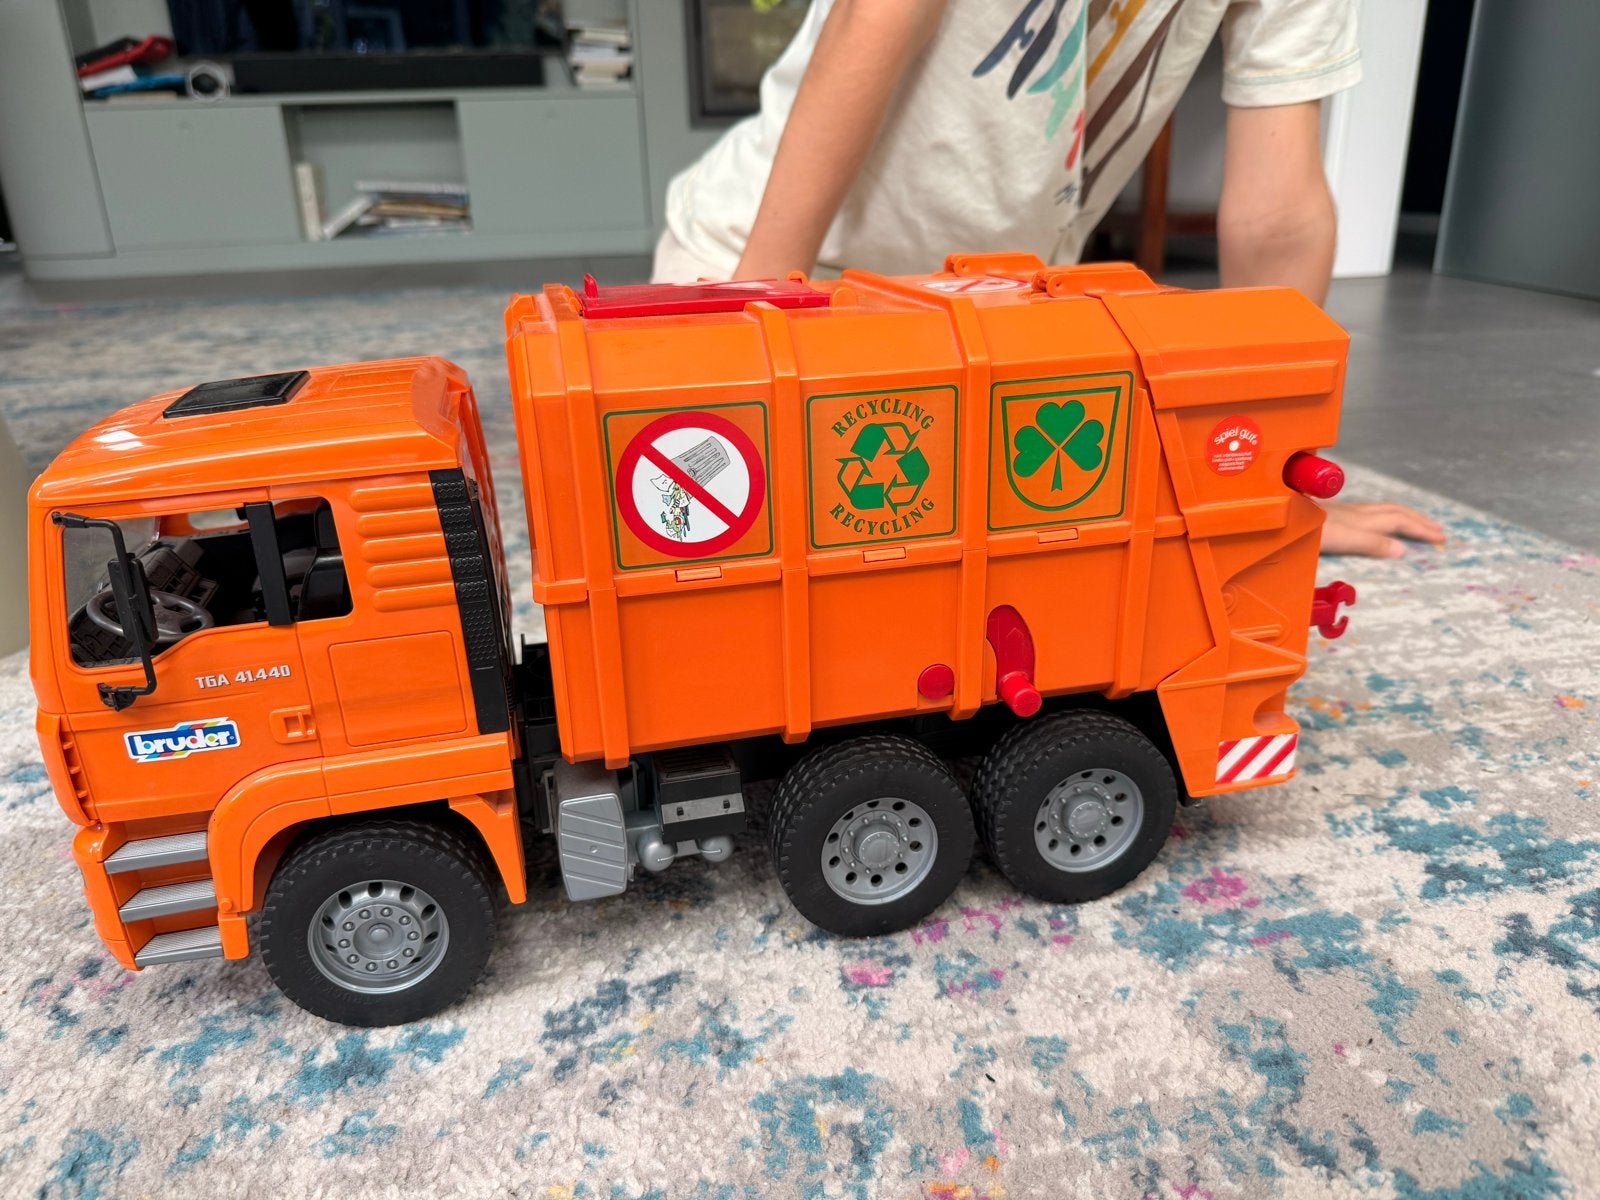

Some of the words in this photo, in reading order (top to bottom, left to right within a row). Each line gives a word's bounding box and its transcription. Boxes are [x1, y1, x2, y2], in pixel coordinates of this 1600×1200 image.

[831, 398, 935, 437] RECYCLING
[1213, 426, 1239, 445] spiel
[829, 497, 935, 535] RECYCLING
[194, 674, 231, 689] TGA
[235, 664, 291, 683] 41.440
[133, 728, 231, 755] bruder
